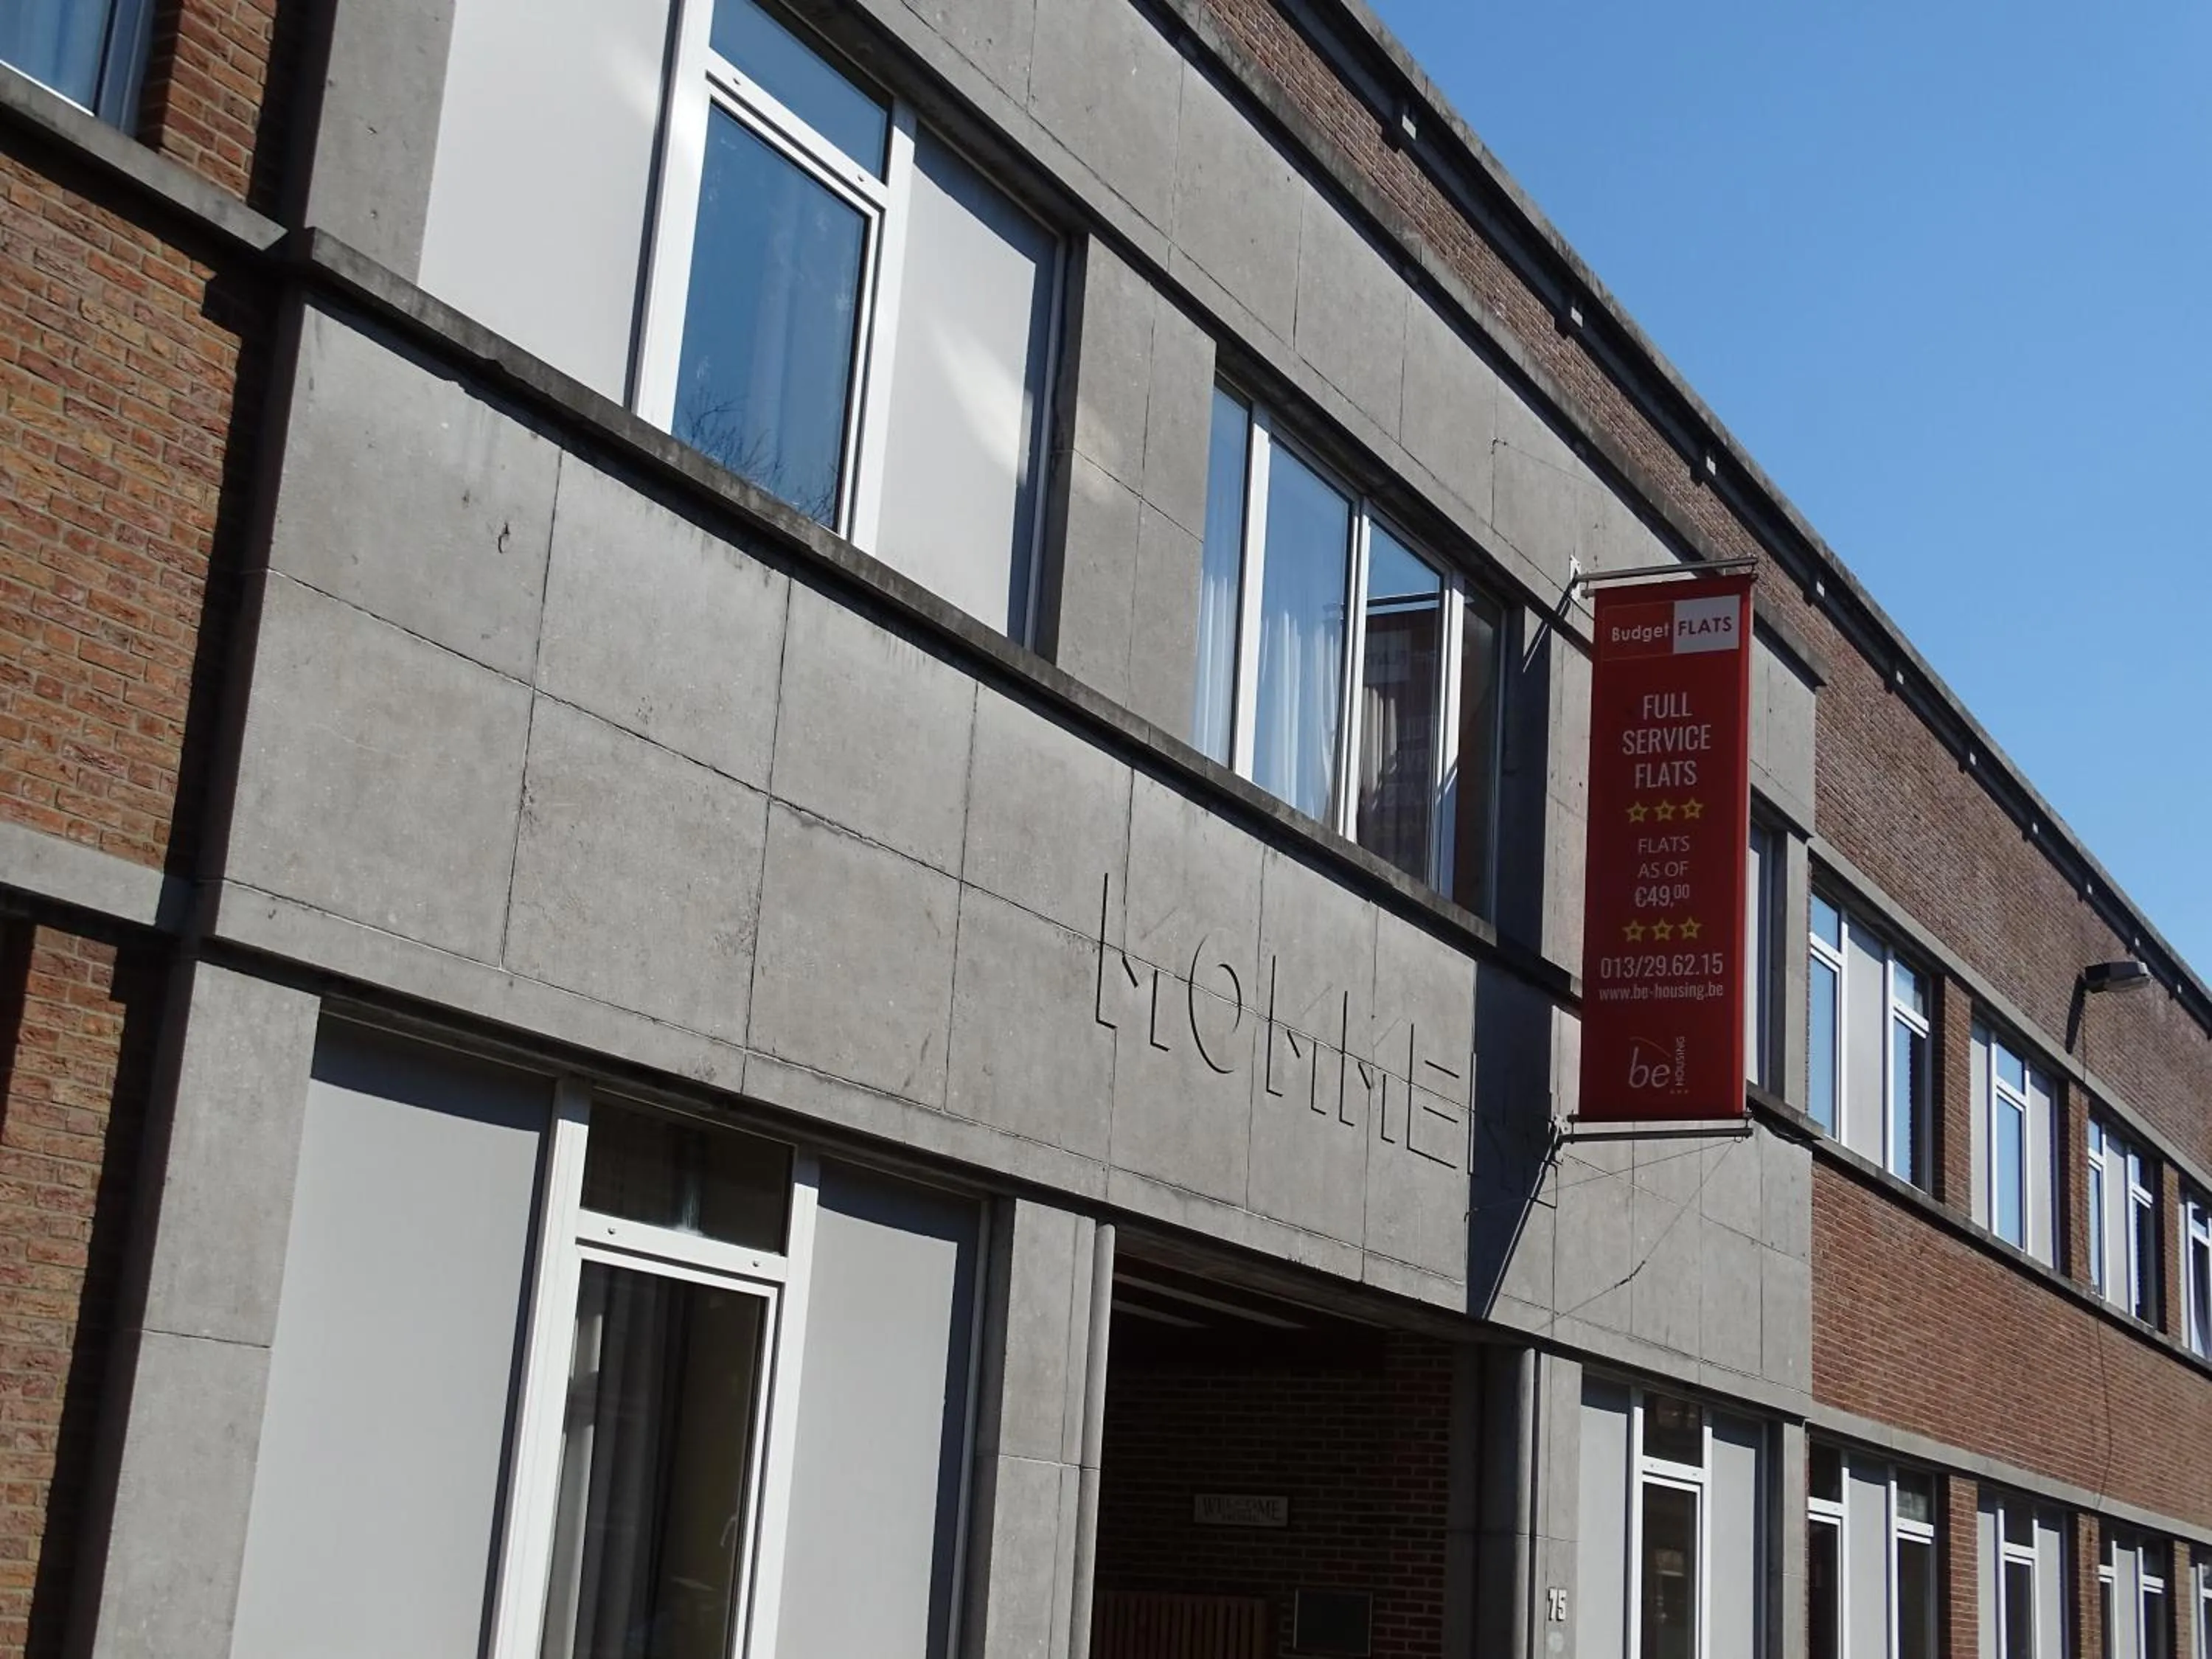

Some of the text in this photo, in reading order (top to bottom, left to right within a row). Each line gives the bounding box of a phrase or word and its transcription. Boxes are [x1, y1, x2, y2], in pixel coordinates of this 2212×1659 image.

[1610, 616, 1733, 643] Budget FLATS
[1642, 692, 1693, 720] FULL
[1622, 725, 1711, 755] SERVICE
[1635, 760, 1697, 790] FLATS
[1638, 835, 1690, 854] FLATS
[1638, 860, 1688, 879] AS OF
[1600, 953, 1723, 979] 013/29.62.15
[1599, 981, 1723, 1001] www.be-housing.be
[1628, 1046, 1672, 1088] be
[1674, 1036, 1686, 1086] HOUSING
[1548, 1587, 1567, 1621] 75
